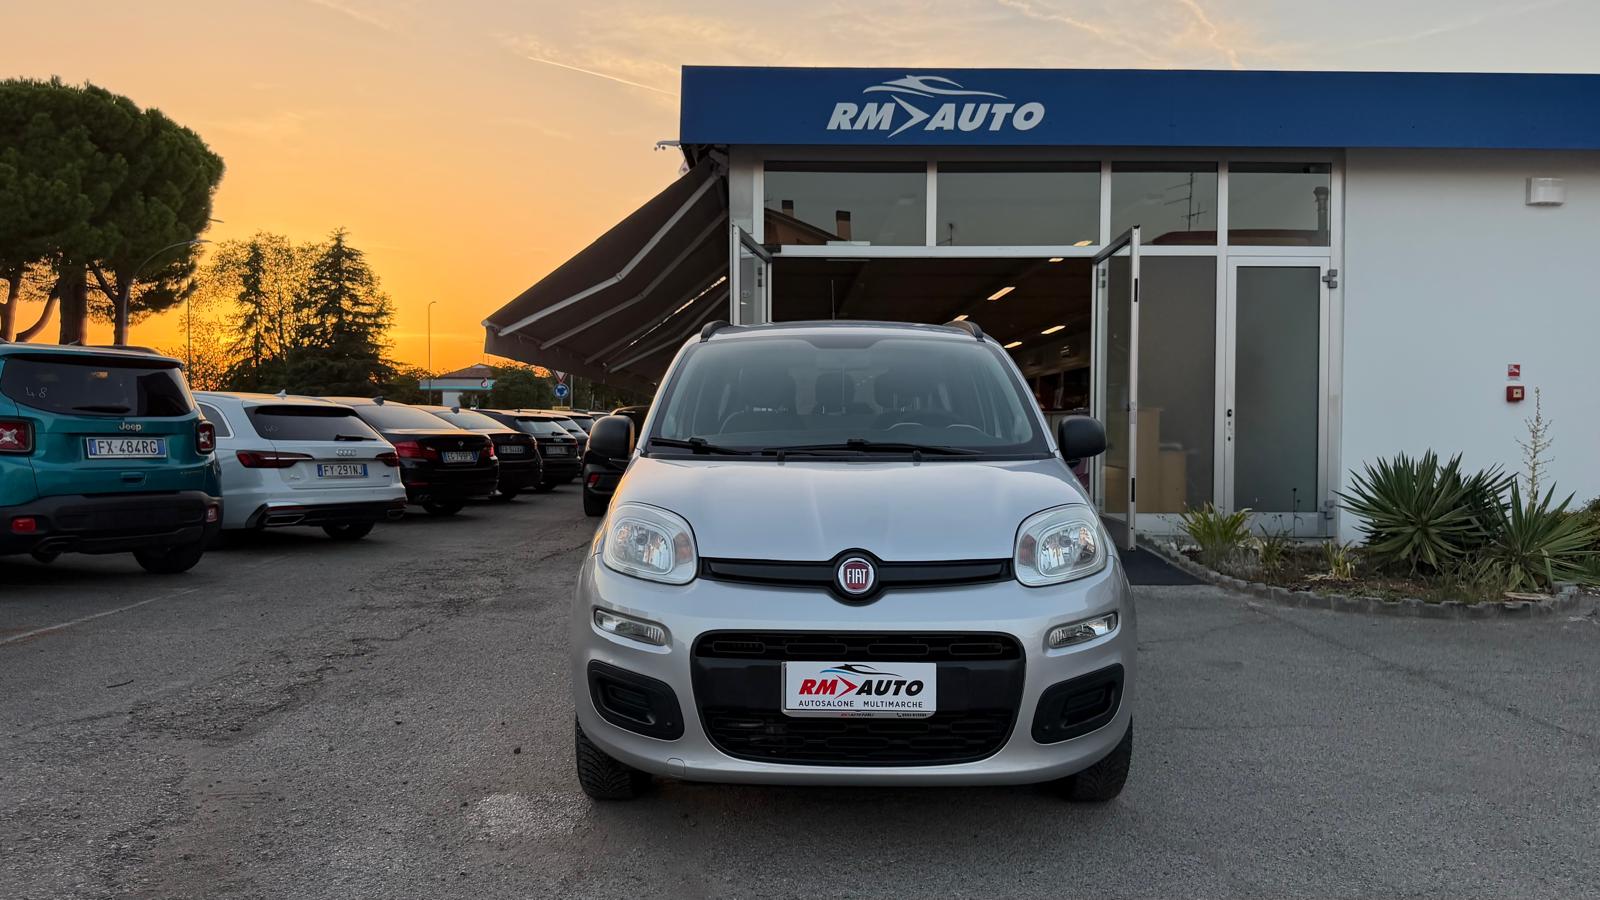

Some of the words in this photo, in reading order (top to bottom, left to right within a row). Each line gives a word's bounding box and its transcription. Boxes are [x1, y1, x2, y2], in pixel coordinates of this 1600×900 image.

[924, 102, 1045, 131] AUTO
[119, 422, 142, 432] Jeep
[97, 440, 114, 455] FX
[119, 440, 158, 455] 484RG
[846, 568, 868, 584] FIAT
[855, 679, 924, 697] AUTO
[799, 700, 855, 708] AUTOSALONE
[863, 700, 924, 709] MULTIMARCHE
